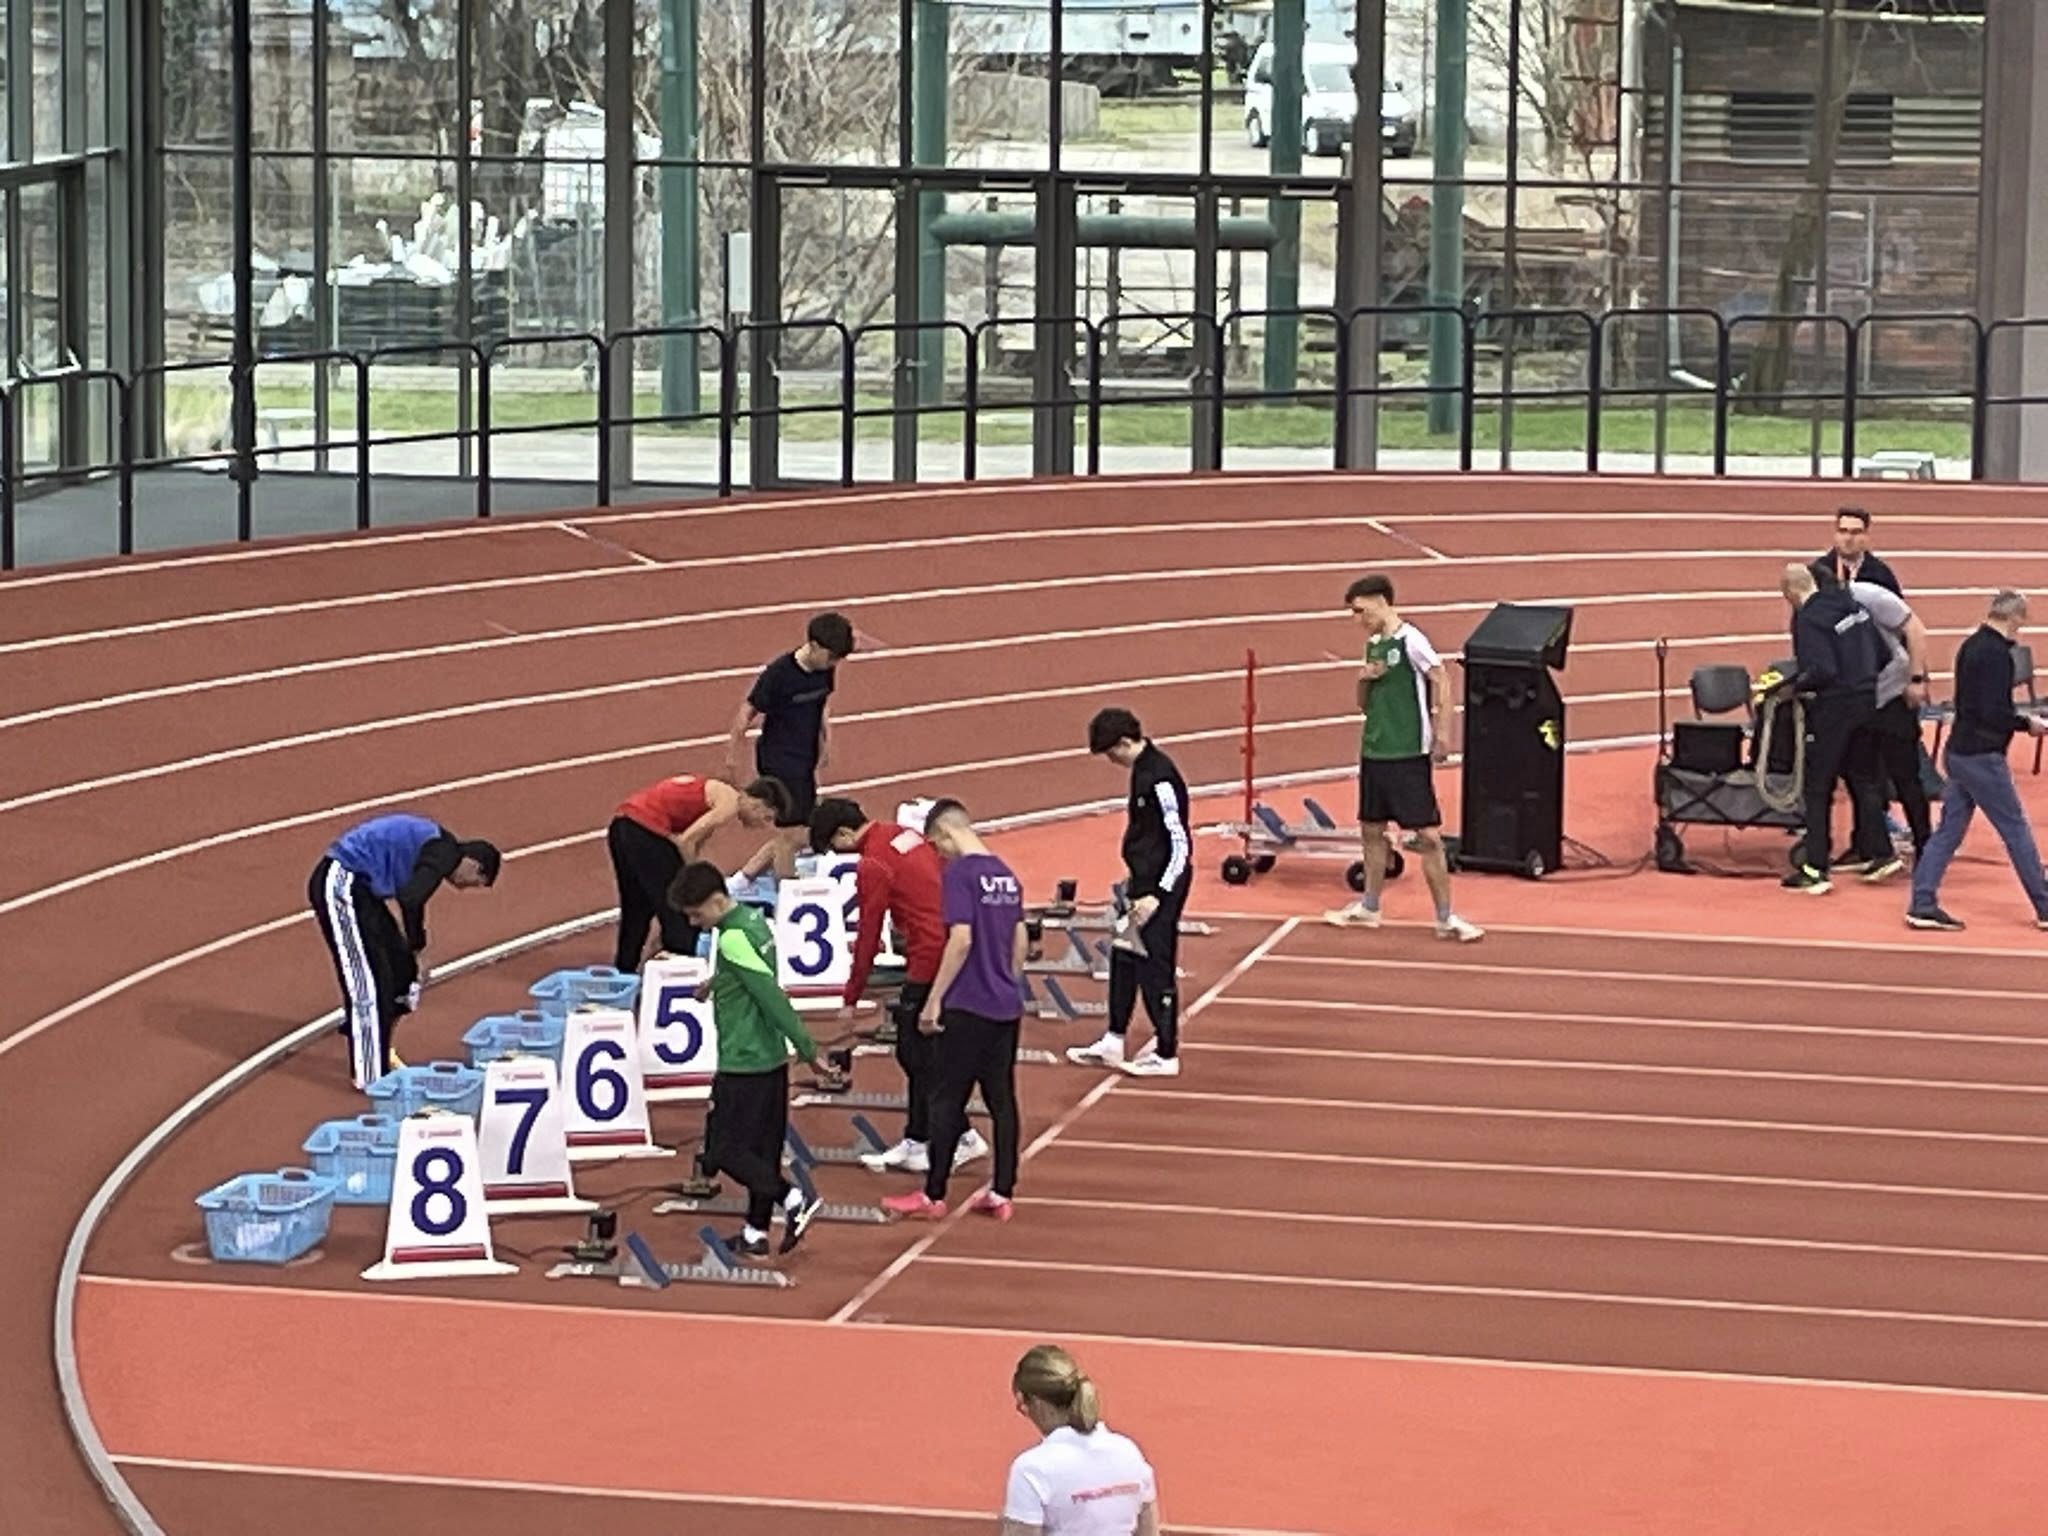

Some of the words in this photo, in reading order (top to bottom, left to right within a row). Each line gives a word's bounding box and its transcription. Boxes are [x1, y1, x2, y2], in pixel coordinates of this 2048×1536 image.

[787, 903, 833, 977] 3
[653, 986, 703, 1064] 5
[575, 1040, 629, 1121] 6
[495, 1088, 550, 1175] 7
[410, 1147, 467, 1235] 8
